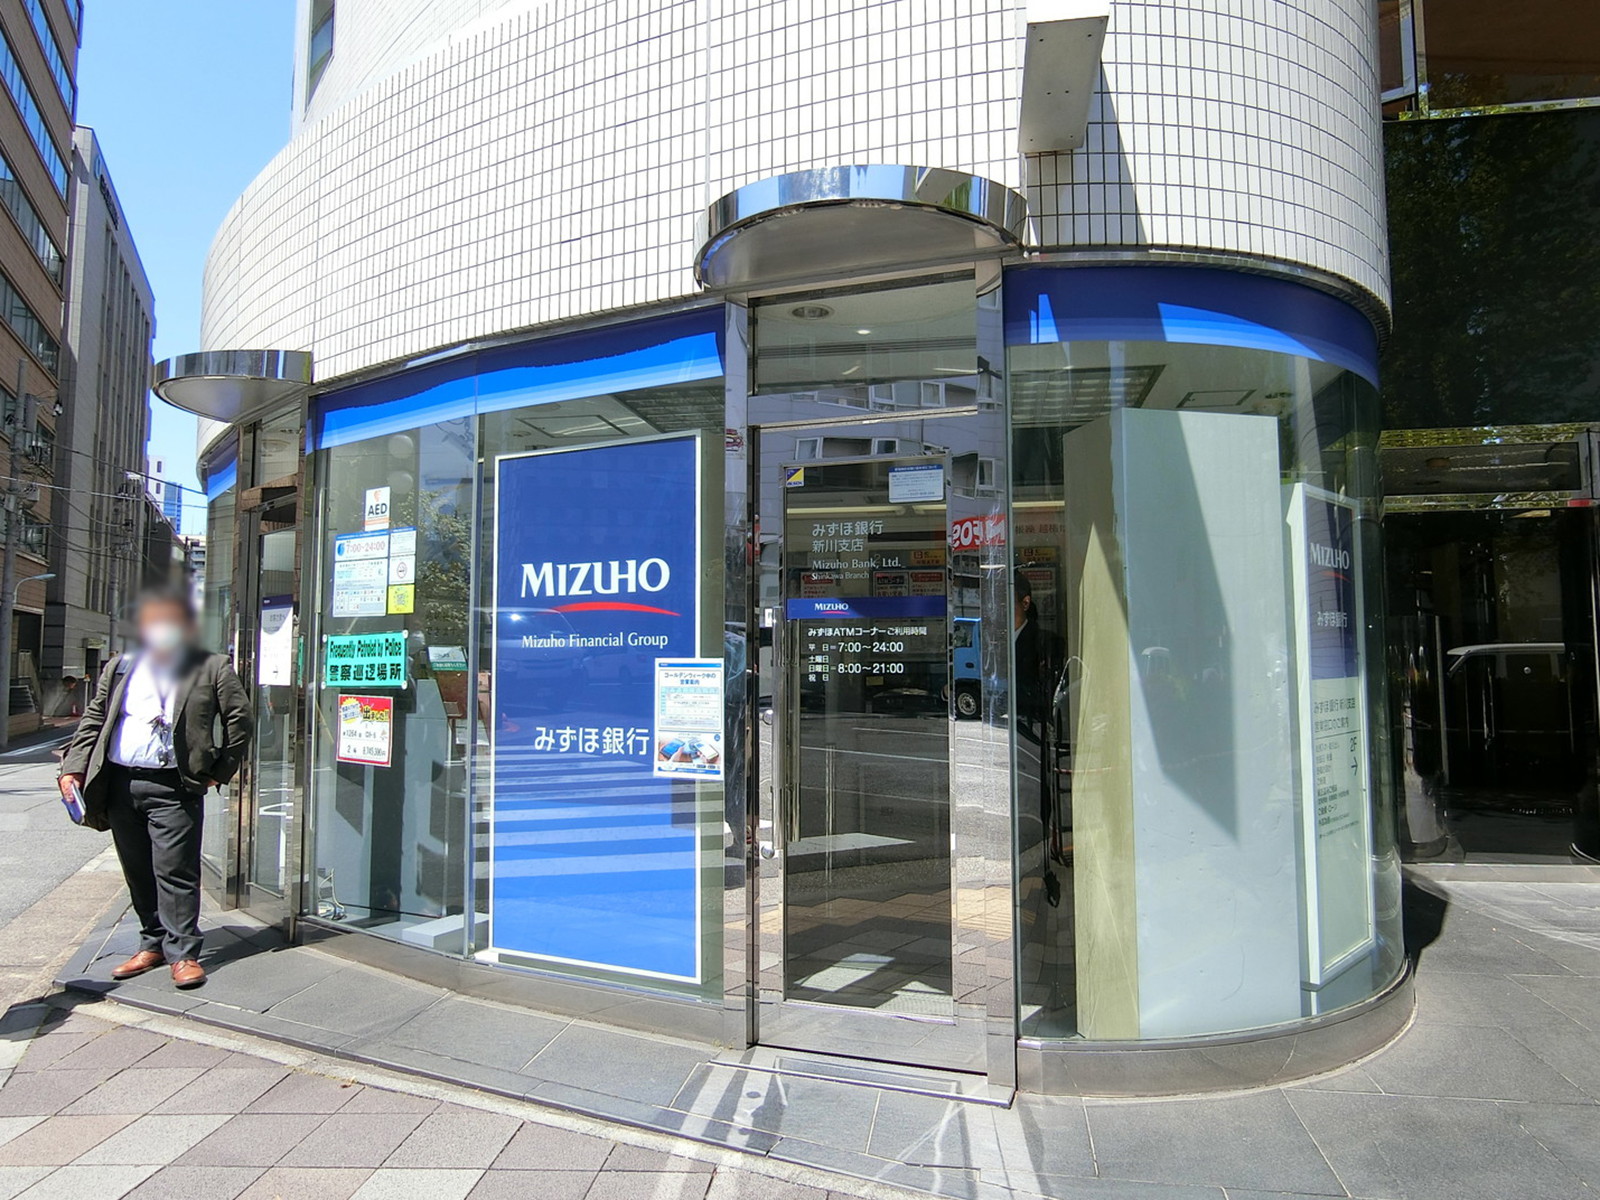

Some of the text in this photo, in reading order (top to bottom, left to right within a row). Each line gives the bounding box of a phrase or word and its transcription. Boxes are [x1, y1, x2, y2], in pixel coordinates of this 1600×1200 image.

[367, 502, 388, 517] AED
[812, 520, 884, 537] みずほ銀行
[812, 538, 864, 553] 新川支店
[1310, 541, 1350, 570] MIZUHO
[812, 560, 849, 570] Mizuho
[852, 558, 880, 570] Bank,
[882, 557, 902, 568] Ltd.
[521, 558, 671, 598] MIZUHO
[811, 572, 844, 581] Shinkawa
[845, 571, 870, 580] Branch
[814, 602, 849, 611] MIZUHO
[1316, 611, 1348, 628] みずほ銀行
[807, 626, 928, 637] みずほATMコーナーご利用時間
[385, 638, 402, 656] Police
[522, 631, 669, 649] Mizuho Financial Group
[808, 655, 829, 664] 土曜日
[808, 664, 829, 673] 日曜日
[534, 725, 650, 756] みずほ銀行
